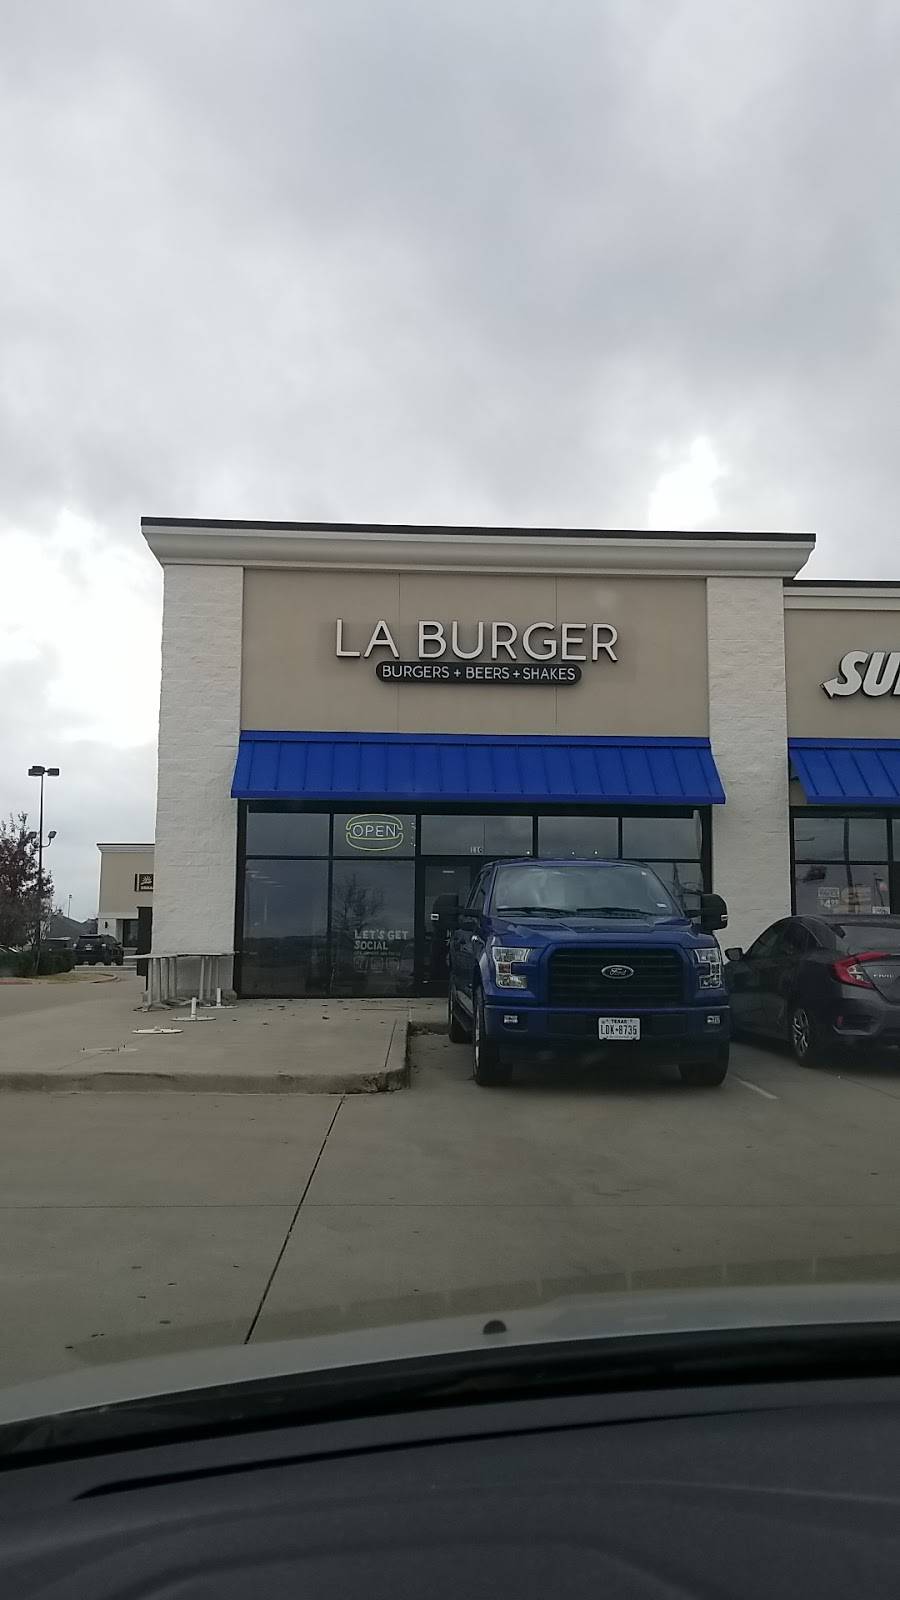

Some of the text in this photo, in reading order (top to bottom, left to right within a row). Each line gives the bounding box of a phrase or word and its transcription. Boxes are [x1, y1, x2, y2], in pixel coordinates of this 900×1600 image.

[335, 618, 619, 662] LA BURGER
[382, 665, 450, 679] BURGERS
[465, 667, 510, 680] BEERS
[522, 667, 576, 681] SHAKES
[819, 650, 900, 698] SU
[352, 824, 397, 838] OPEN
[354, 929, 409, 940] LET'S GET
[354, 940, 389, 951] SOCIAL
